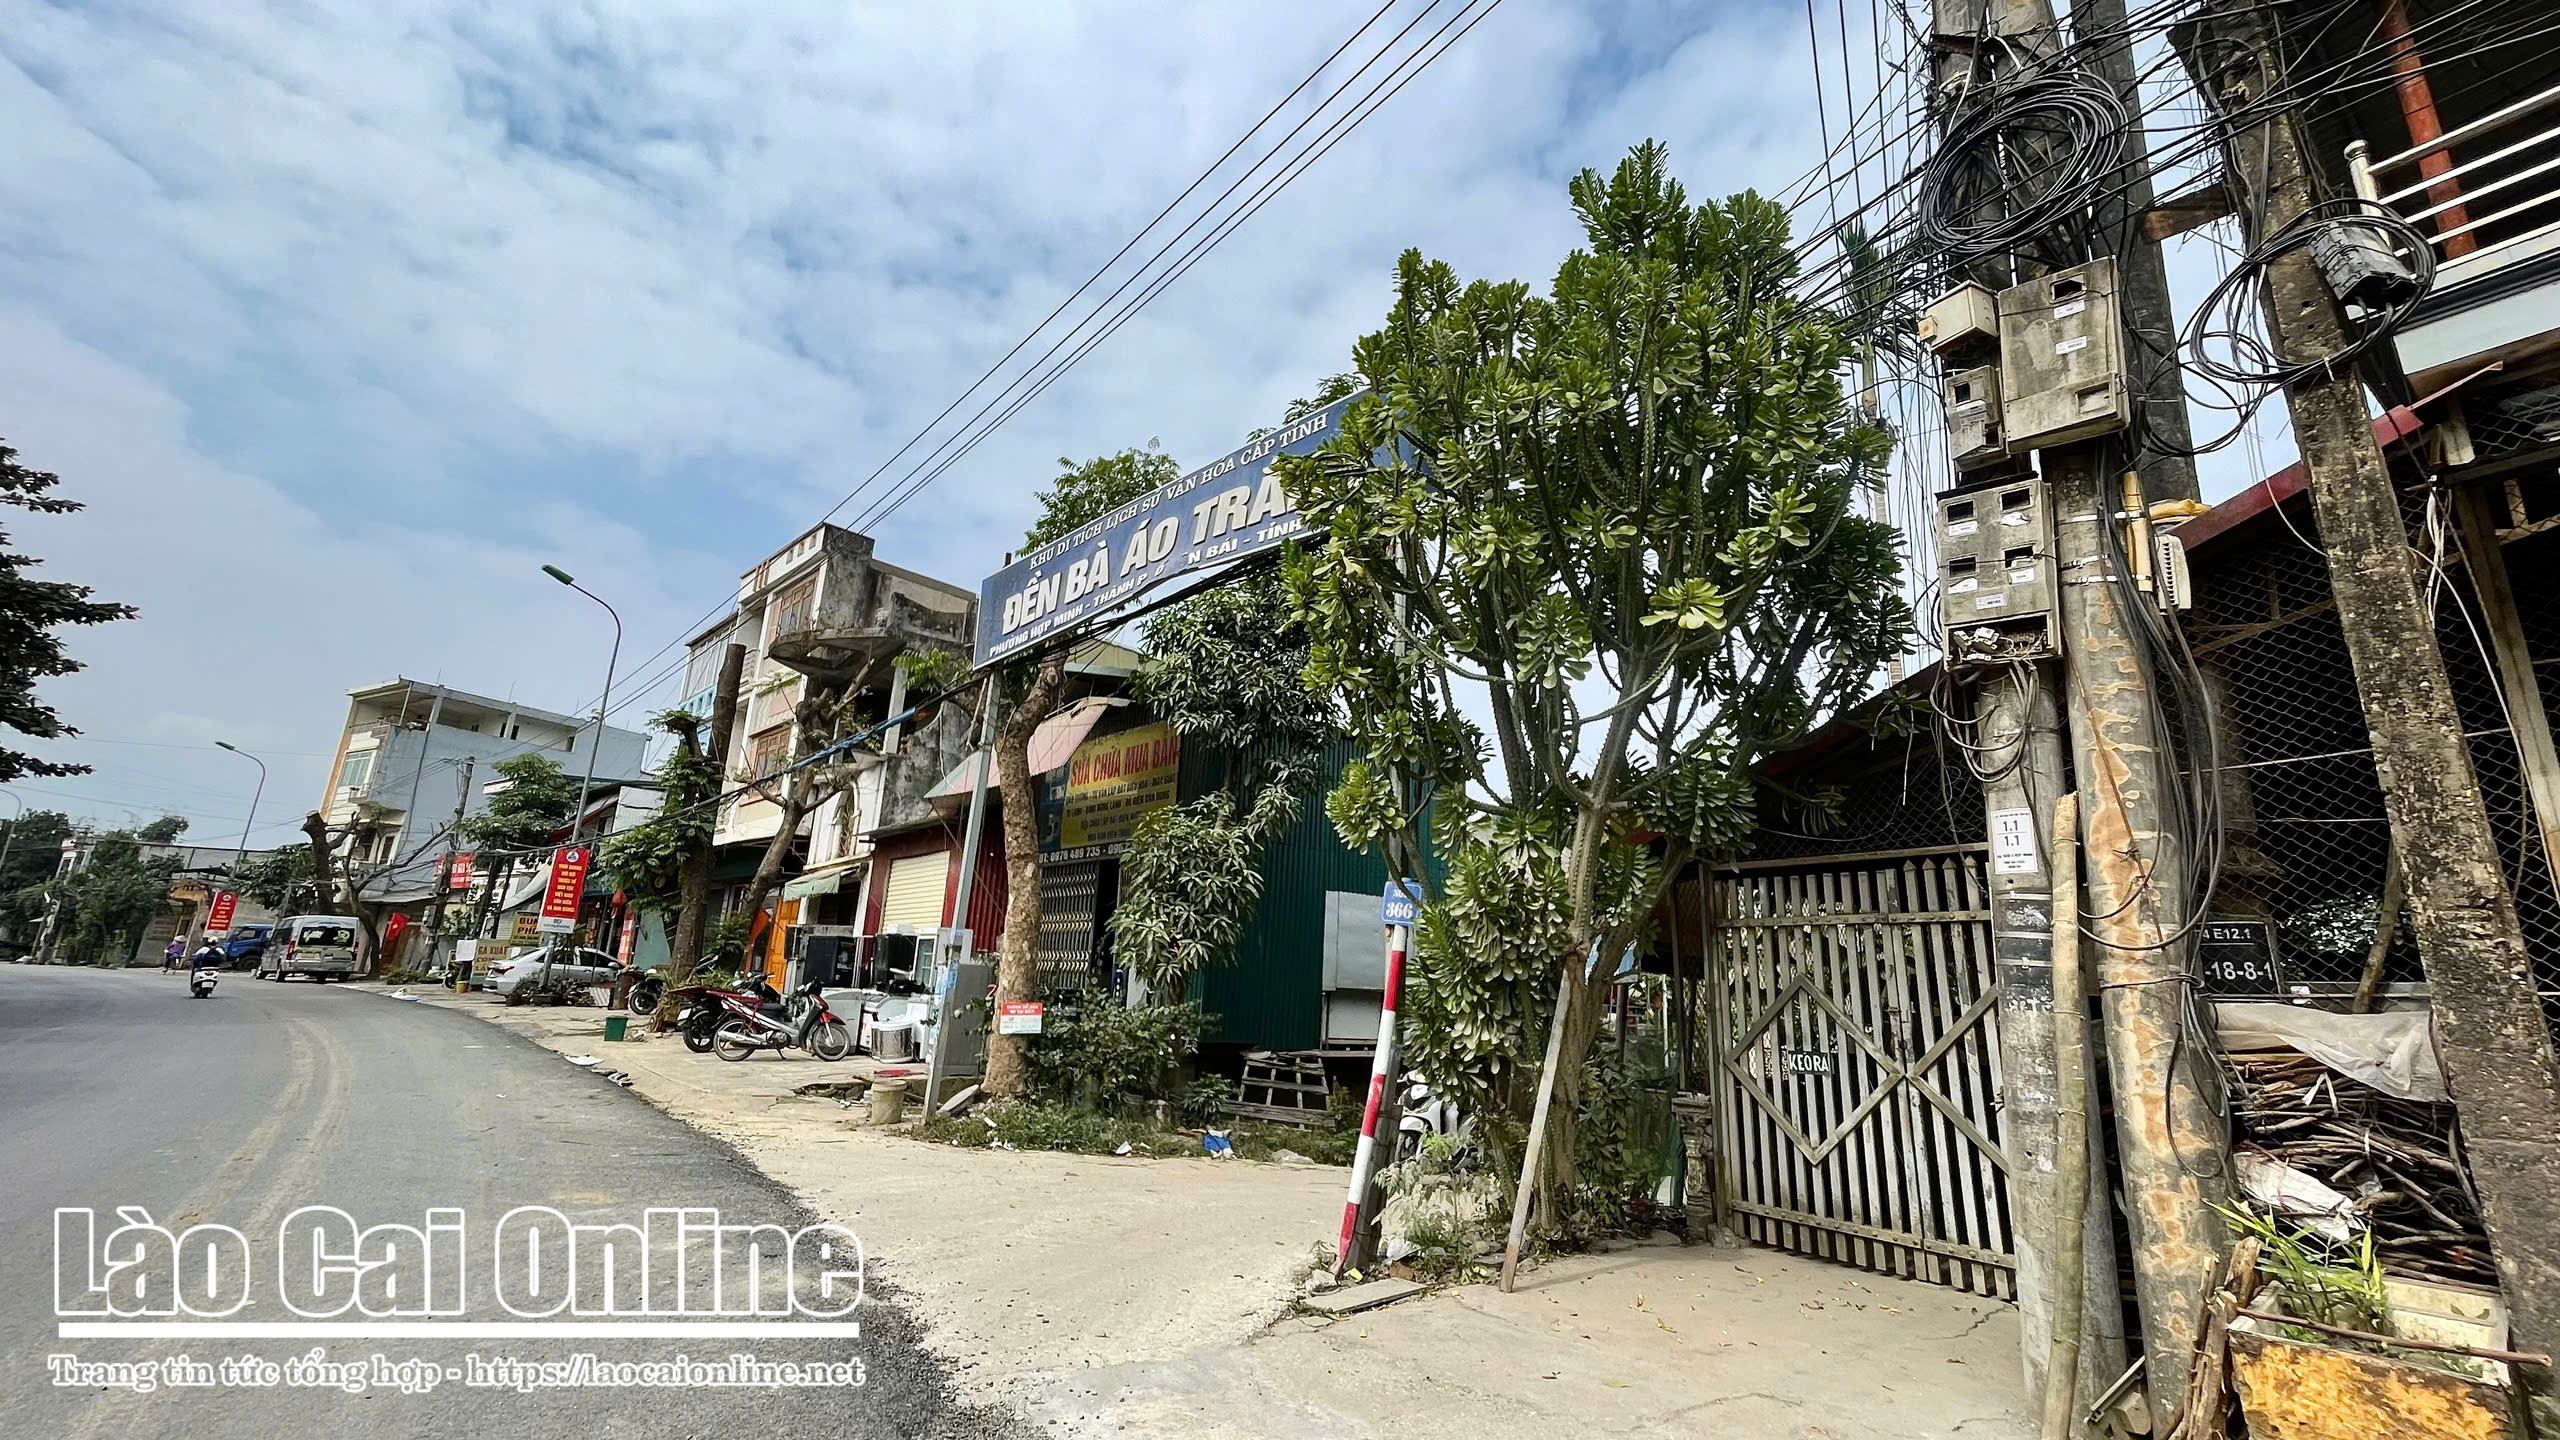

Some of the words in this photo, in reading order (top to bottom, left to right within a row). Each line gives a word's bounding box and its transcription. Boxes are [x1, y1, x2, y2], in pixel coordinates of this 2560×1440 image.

[1029, 547, 1055, 571] KHU
[1057, 540, 1071, 560] DI
[1072, 521, 1103, 548] TÍCH
[1104, 508, 1138, 532] LỊCH
[1166, 473, 1199, 501] VĂN
[1200, 457, 1237, 486] HÓA
[1279, 413, 1330, 449] TỈNH
[1002, 569, 1063, 636] ĐỀN
[1065, 541, 1111, 606] BÀ
[1120, 516, 1180, 579] ÁO
[1193, 455, 1298, 546] TRẮ
[989, 629, 1029, 658] PHƯỜNG
[1030, 619, 1052, 641] HỢP
[1053, 605, 1084, 629] MINH
[1093, 578, 1135, 608] THÀNH
[1206, 536, 1239, 561] BÁI
[1256, 520, 1303, 544] TỈNH
[1124, 743, 1149, 775] MUA
[2003, 820, 2019, 832] 1.1
[2004, 835, 2020, 847] 1.1
[1086, 846, 1101, 858] 735
[1385, 901, 1414, 919] 366
[2212, 928, 2251, 940] E12.1
